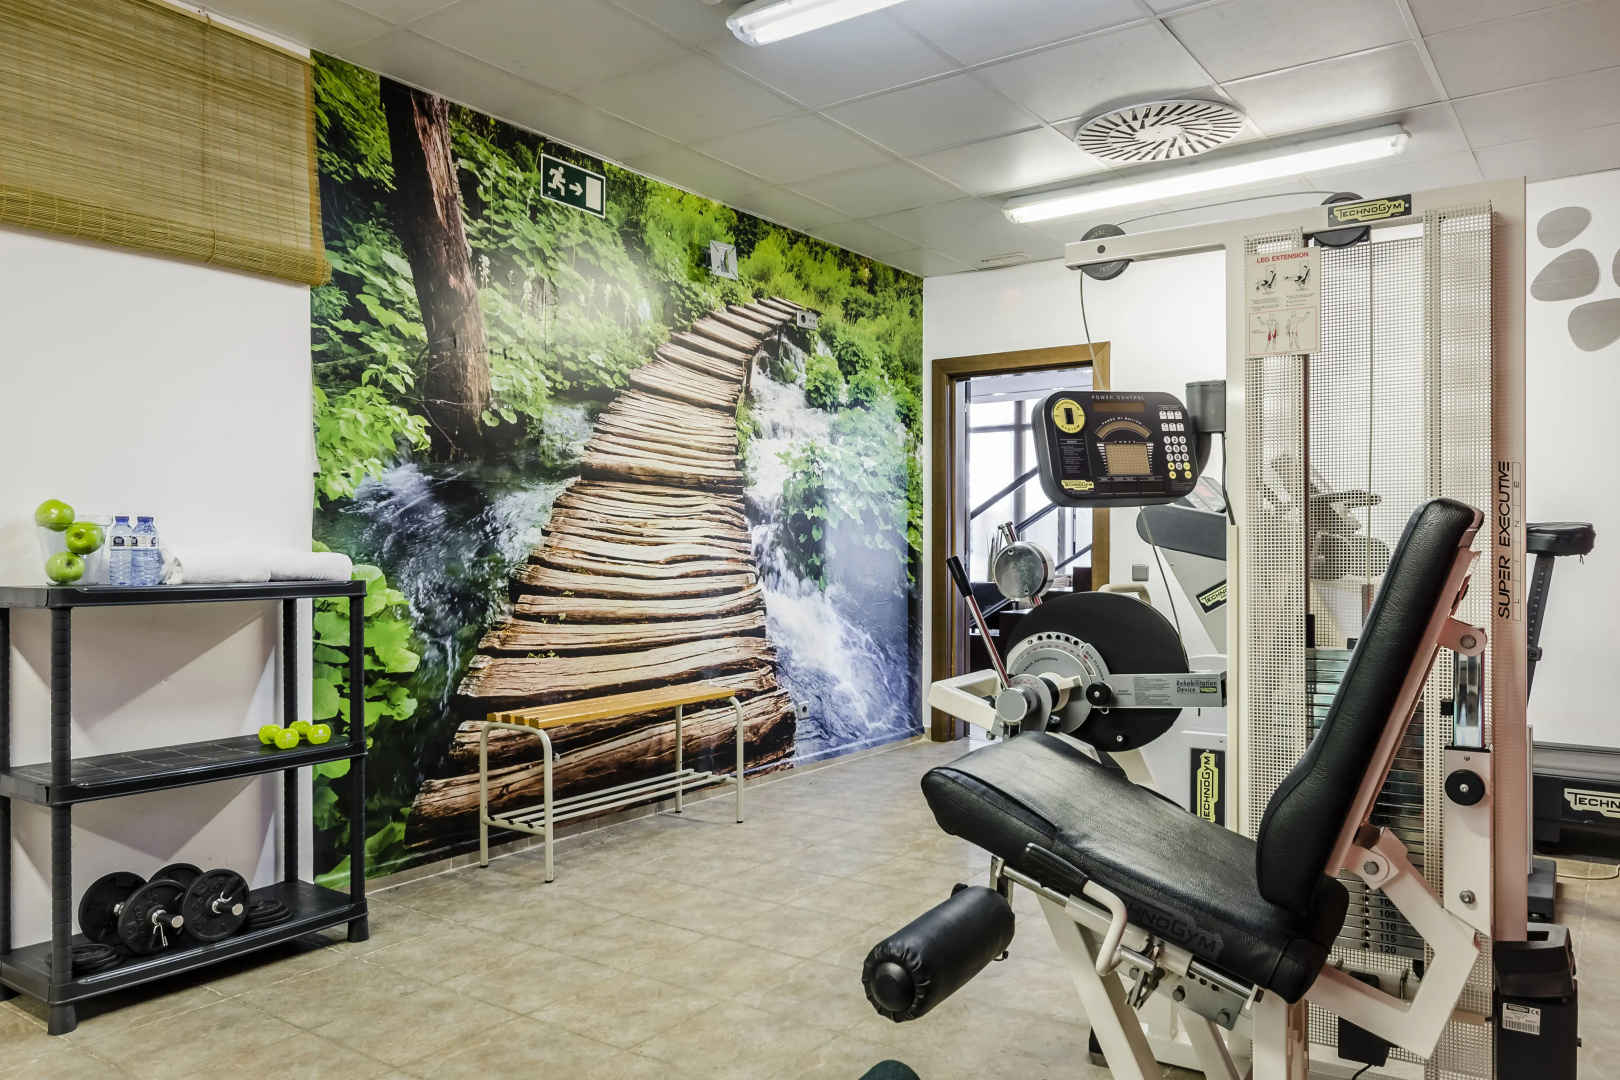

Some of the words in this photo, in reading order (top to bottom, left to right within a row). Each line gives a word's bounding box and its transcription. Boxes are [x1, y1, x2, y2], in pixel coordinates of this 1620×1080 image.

[1336, 202, 1402, 219] TECHNOGYM
[1256, 256, 1270, 264] LEG
[1271, 251, 1309, 262] EXTENSION
[1498, 461, 1511, 547] EXECUTIVE
[1498, 555, 1511, 619] SUPER
[1176, 679, 1218, 687] Rehabilitation
[1200, 756, 1214, 821] TECHNOGYM
[1379, 910, 1397, 919] 105
[1379, 922, 1397, 931] 110
[1379, 933, 1397, 943] 115
[1379, 945, 1397, 954] 120
